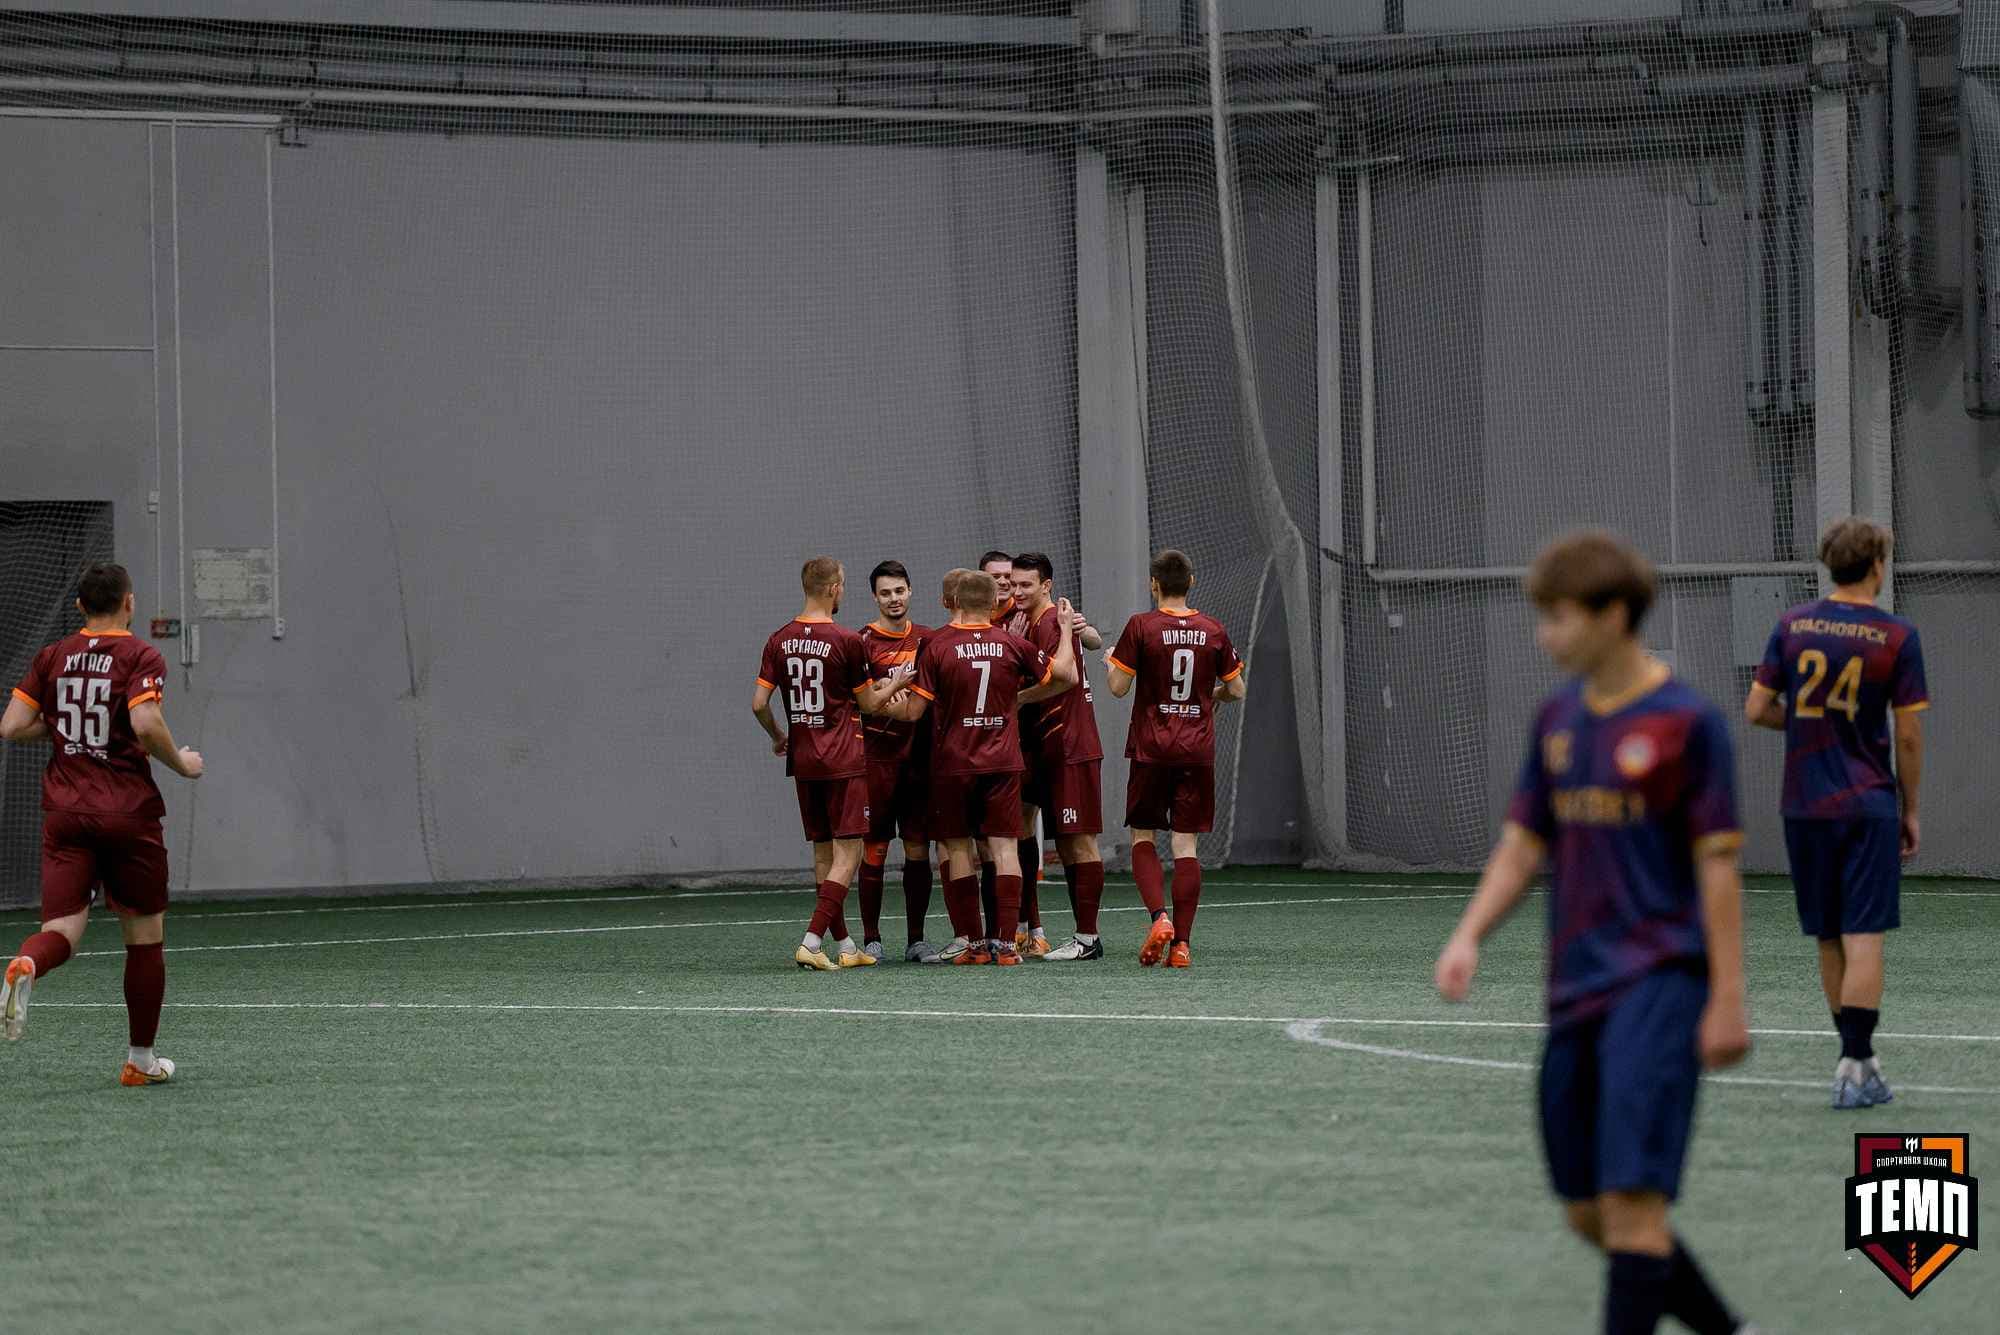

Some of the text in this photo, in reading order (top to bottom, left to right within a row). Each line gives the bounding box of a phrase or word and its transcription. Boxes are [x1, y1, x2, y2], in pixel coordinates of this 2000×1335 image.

[1162, 630, 1206, 646] ШИБАЕВ
[781, 638, 832, 658] ЧЕРКАСОВ
[955, 643, 1003, 659] ЖДАНОВ
[64, 654, 113, 673] ХУТАЕВ
[1170, 648, 1195, 701] 9
[786, 657, 825, 713] 33
[972, 661, 991, 714] 7
[1796, 649, 1864, 722] 24
[57, 677, 112, 747] 55
[1159, 704, 1201, 714] SEUS
[963, 716, 1004, 727] SEUS
[1063, 808, 1077, 823] 24
